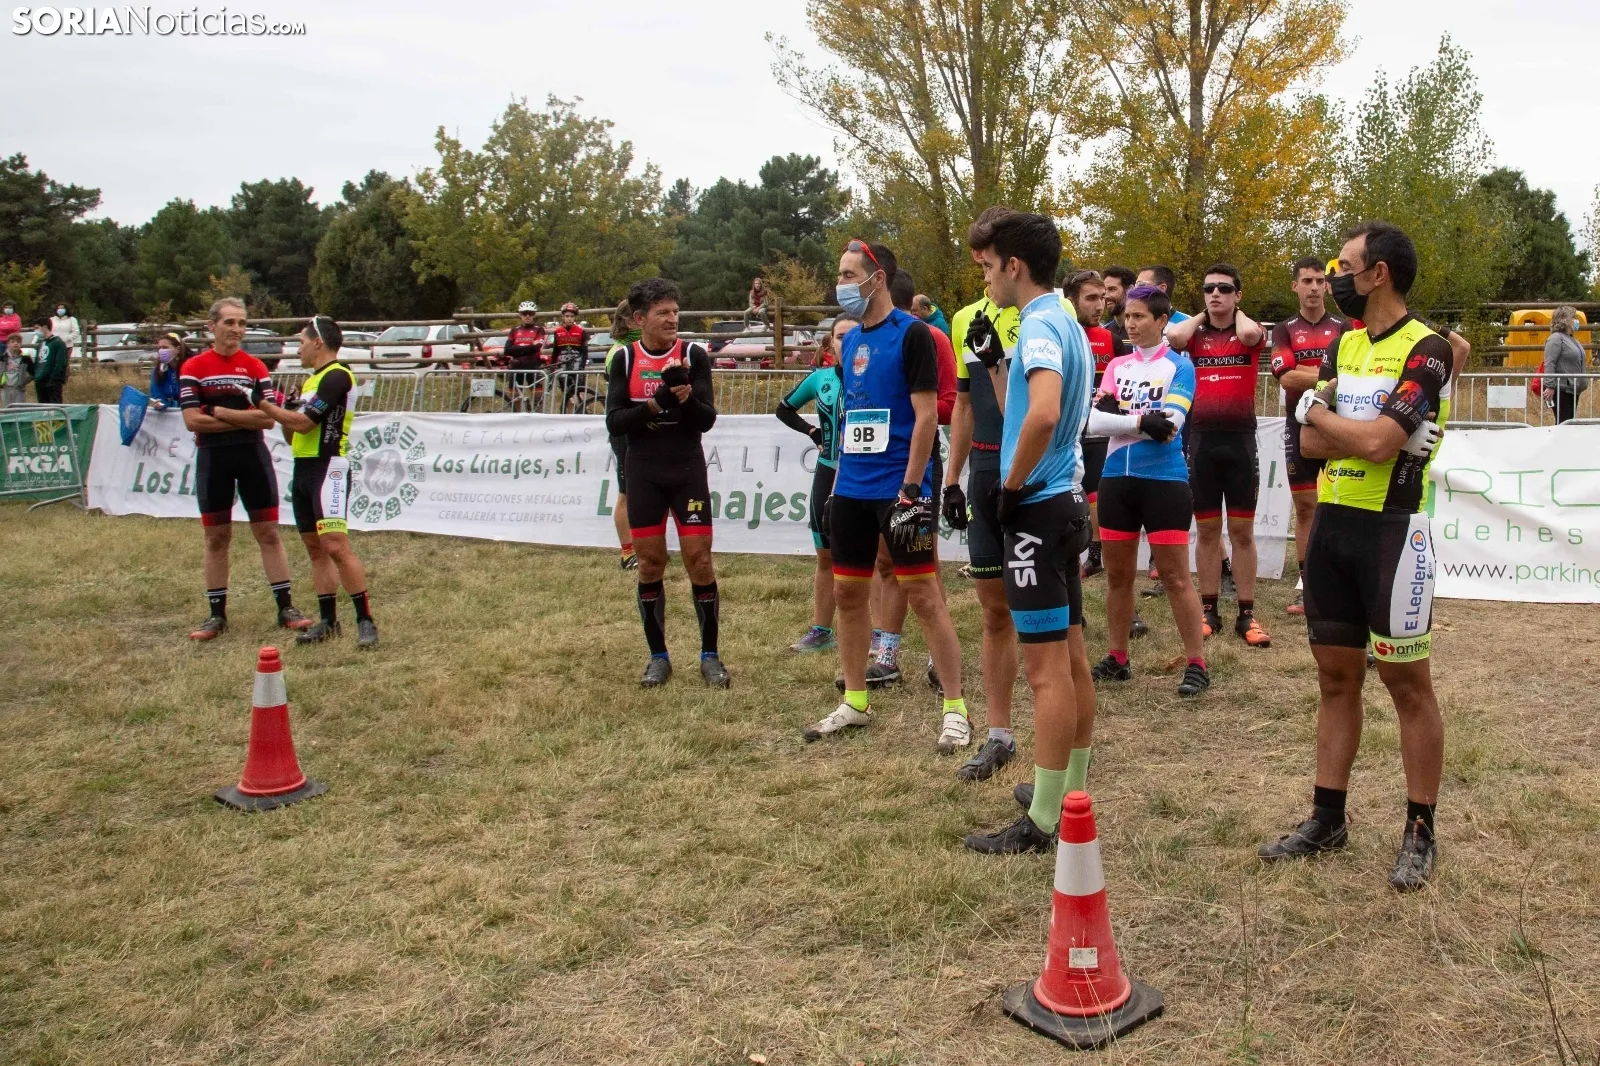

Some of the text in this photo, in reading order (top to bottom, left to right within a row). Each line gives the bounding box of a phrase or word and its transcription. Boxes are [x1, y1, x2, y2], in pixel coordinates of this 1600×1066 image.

[1336, 393, 1371, 405] eclerc
[440, 427, 592, 445] METALICAS
[853, 427, 875, 442] 9B
[8, 454, 73, 473] RGA
[433, 454, 465, 474] Los
[470, 454, 550, 480] Linajes,
[132, 462, 174, 494] Los
[430, 491, 523, 505] CONSTRUCCIONES
[499, 512, 508, 521] Y
[509, 512, 564, 524] CUBIERTAS
[1443, 518, 1584, 545] dehes
[1404, 554, 1426, 631] E.Leclerc
[1021, 612, 1058, 630] Rapha
